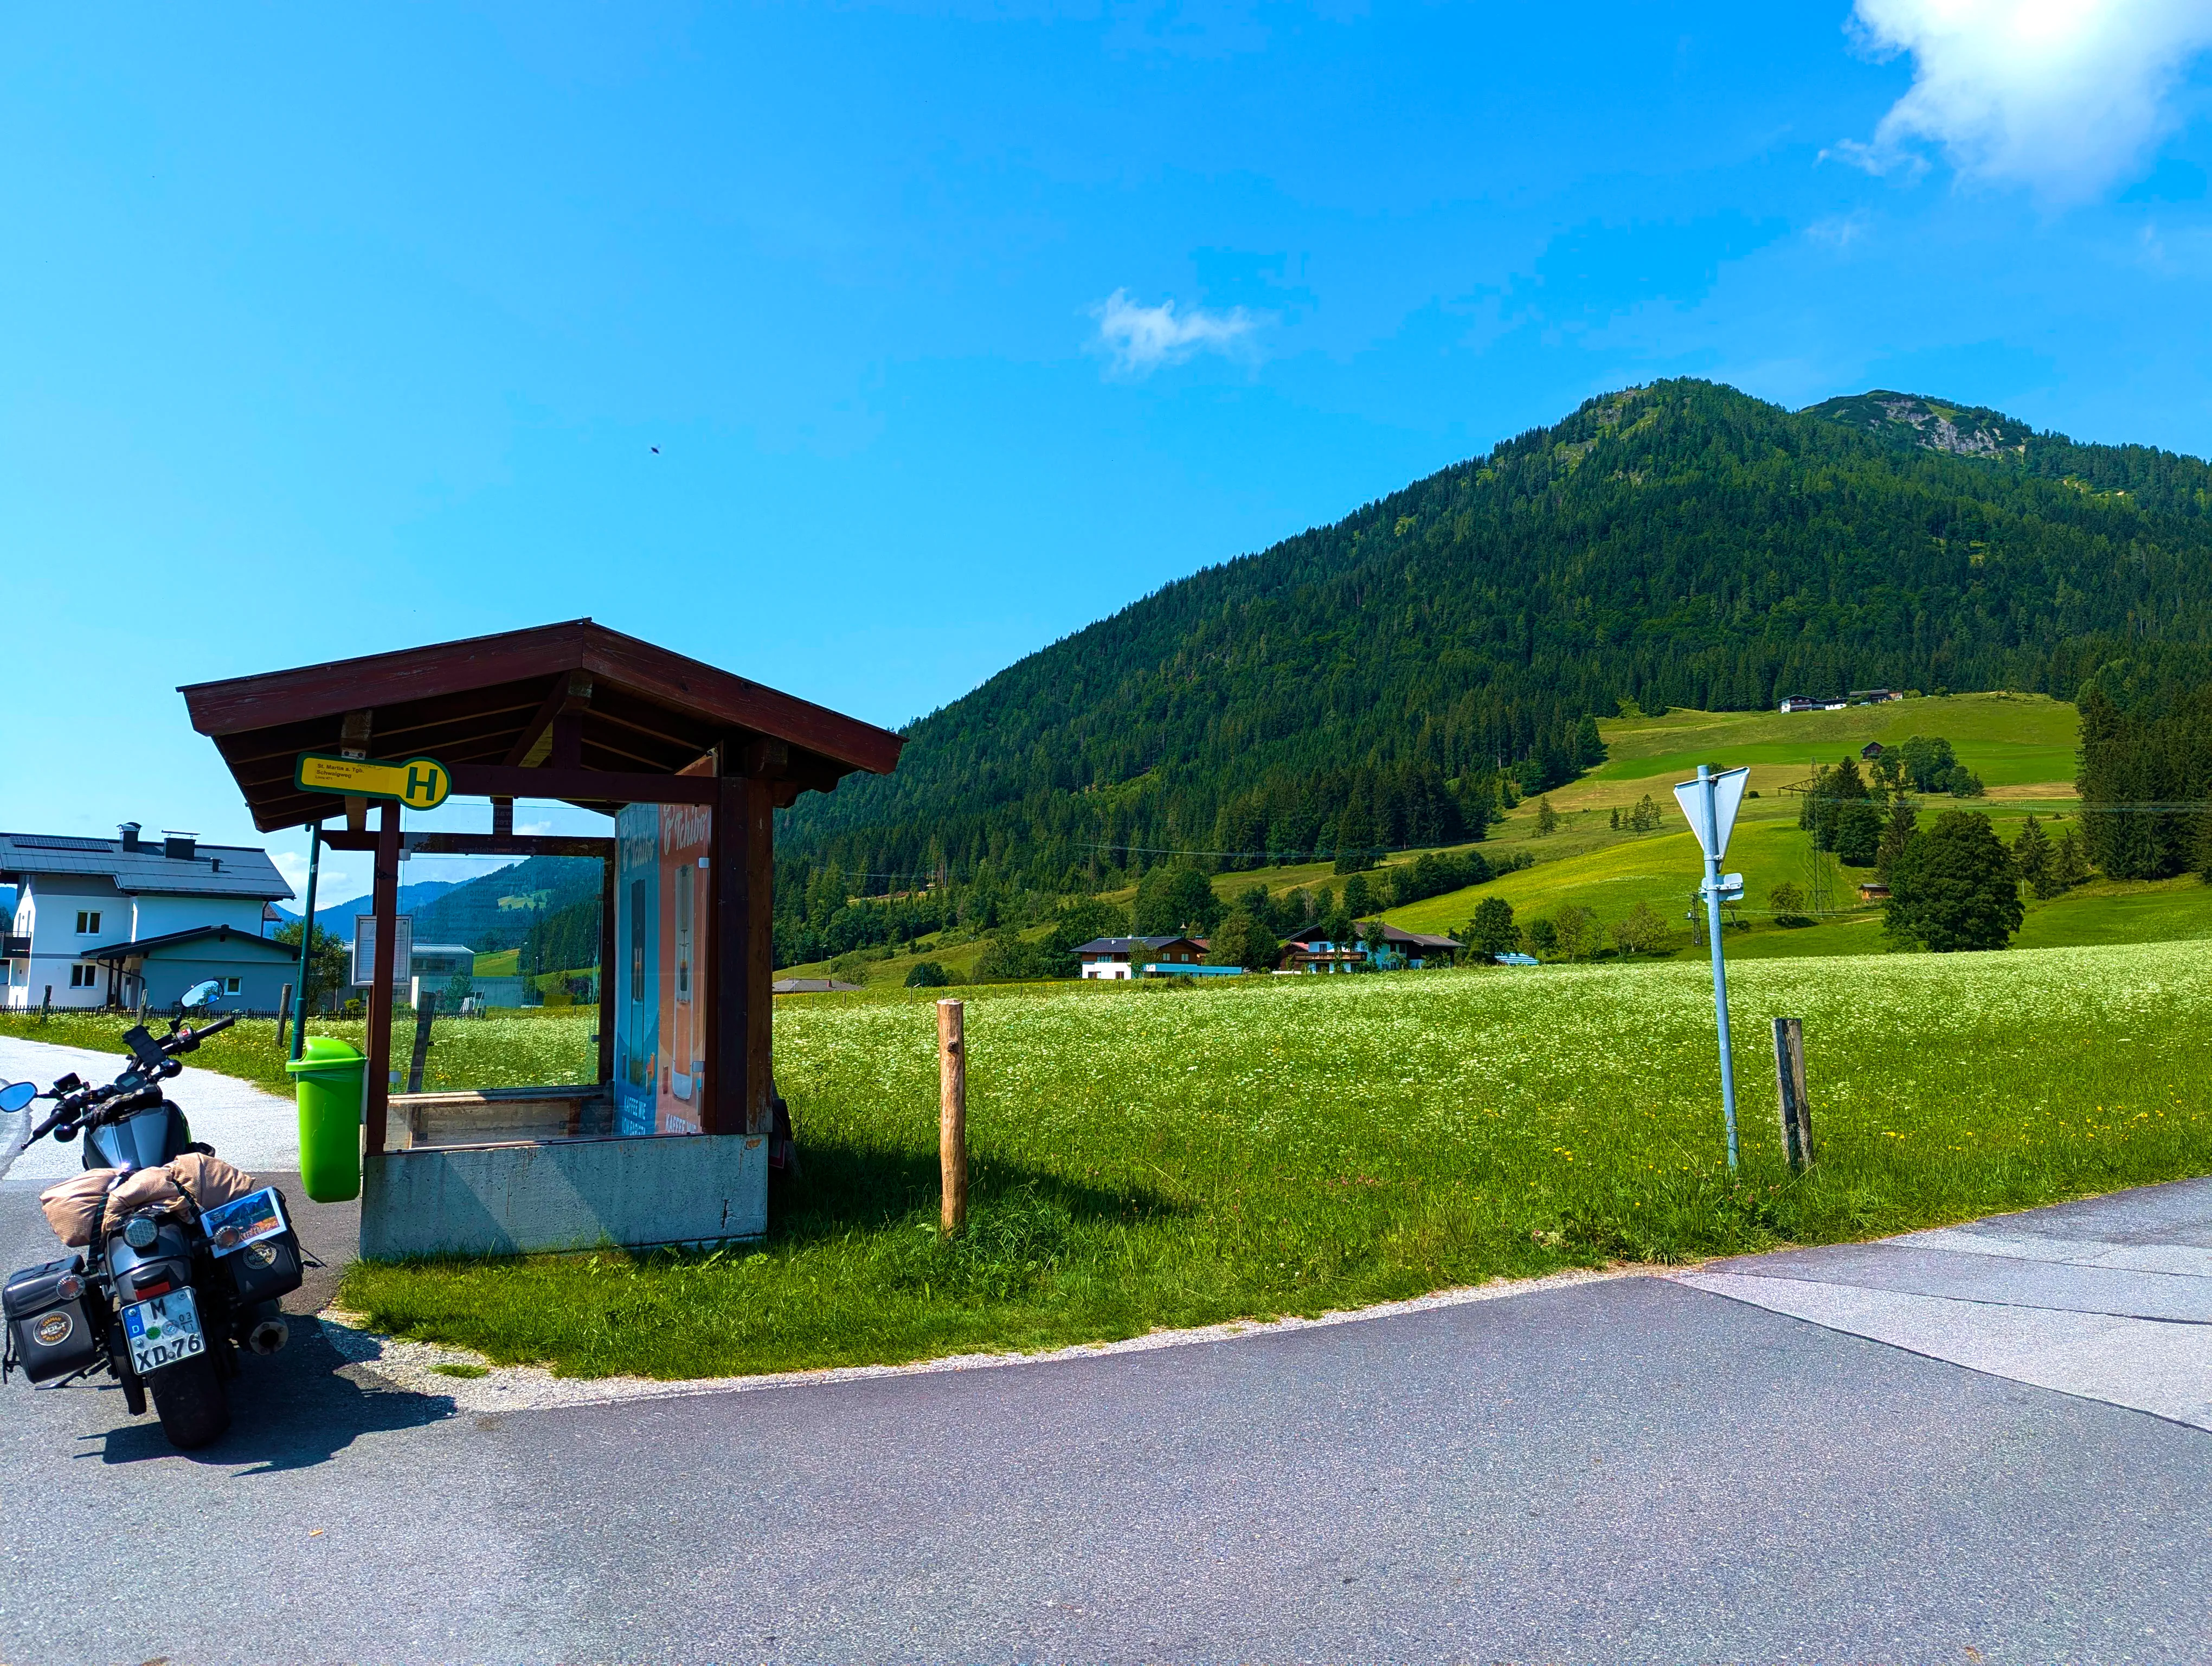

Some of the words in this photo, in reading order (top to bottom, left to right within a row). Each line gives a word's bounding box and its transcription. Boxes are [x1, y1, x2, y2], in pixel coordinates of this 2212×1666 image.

[317, 770, 352, 778] Schwaigweg
[406, 766, 438, 801] H
[674, 806, 708, 850] Tchibo
[631, 830, 655, 868] Tchibo
[624, 1094, 639, 1116] KAFFEE
[666, 1113, 685, 1133] KAFFEE
[150, 1298, 166, 1319] M
[179, 1312, 192, 1322] 03
[40, 1322, 66, 1335] BOLT
[132, 1325, 139, 1334] D
[136, 1345, 168, 1371] XD
[171, 1334, 200, 1357] 76
